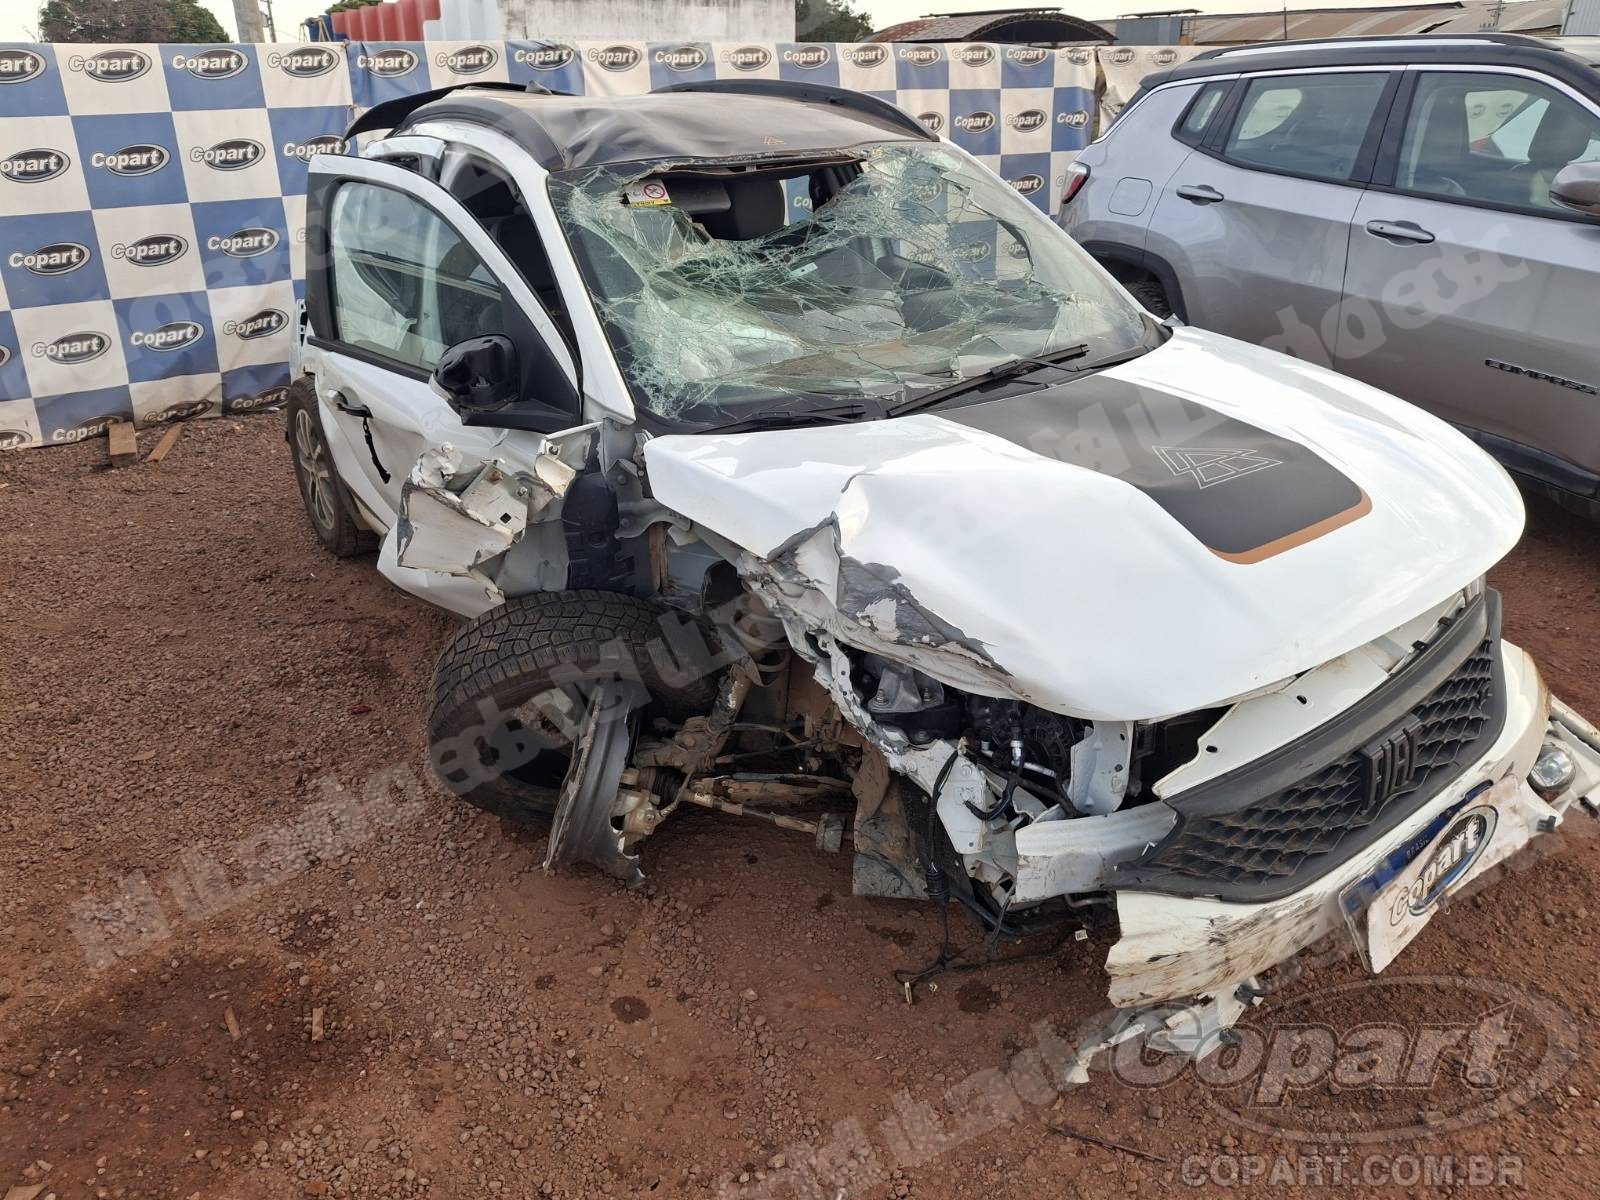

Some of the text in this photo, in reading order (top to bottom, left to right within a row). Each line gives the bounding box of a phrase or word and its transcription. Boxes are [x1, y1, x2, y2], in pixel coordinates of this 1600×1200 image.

[266, 51, 330, 73] Copart
[357, 54, 411, 72] Copart
[435, 50, 490, 69] Copart
[514, 48, 569, 66] Copart
[587, 48, 635, 66] Copart
[655, 50, 701, 68] Copart
[720, 48, 765, 66] Copart
[783, 49, 826, 65] Copart
[842, 48, 882, 62] Copart
[899, 48, 937, 61] Copart
[952, 48, 990, 61] Copart
[1006, 48, 1043, 61] Copart
[0, 57, 34, 74] art
[68, 55, 140, 78] Copart
[172, 53, 239, 77] Copart
[954, 115, 991, 129] Copart
[1006, 113, 1041, 128] Copart
[1057, 112, 1085, 125] Copa
[190, 144, 256, 168] Copart
[283, 141, 344, 156] Copart
[0, 154, 58, 177] opart
[92, 148, 160, 173] Copart
[207, 232, 270, 254] Copart
[9, 249, 80, 271] Copart
[111, 242, 178, 265] Copart
[223, 314, 278, 335] Copart
[131, 327, 195, 349] Copart
[31, 338, 101, 360] Copart
[1485, 359, 1598, 396] COMPASS
[231, 388, 288, 408] Copart
[53, 422, 108, 441] Copar
[1390, 815, 1481, 927] Copart
